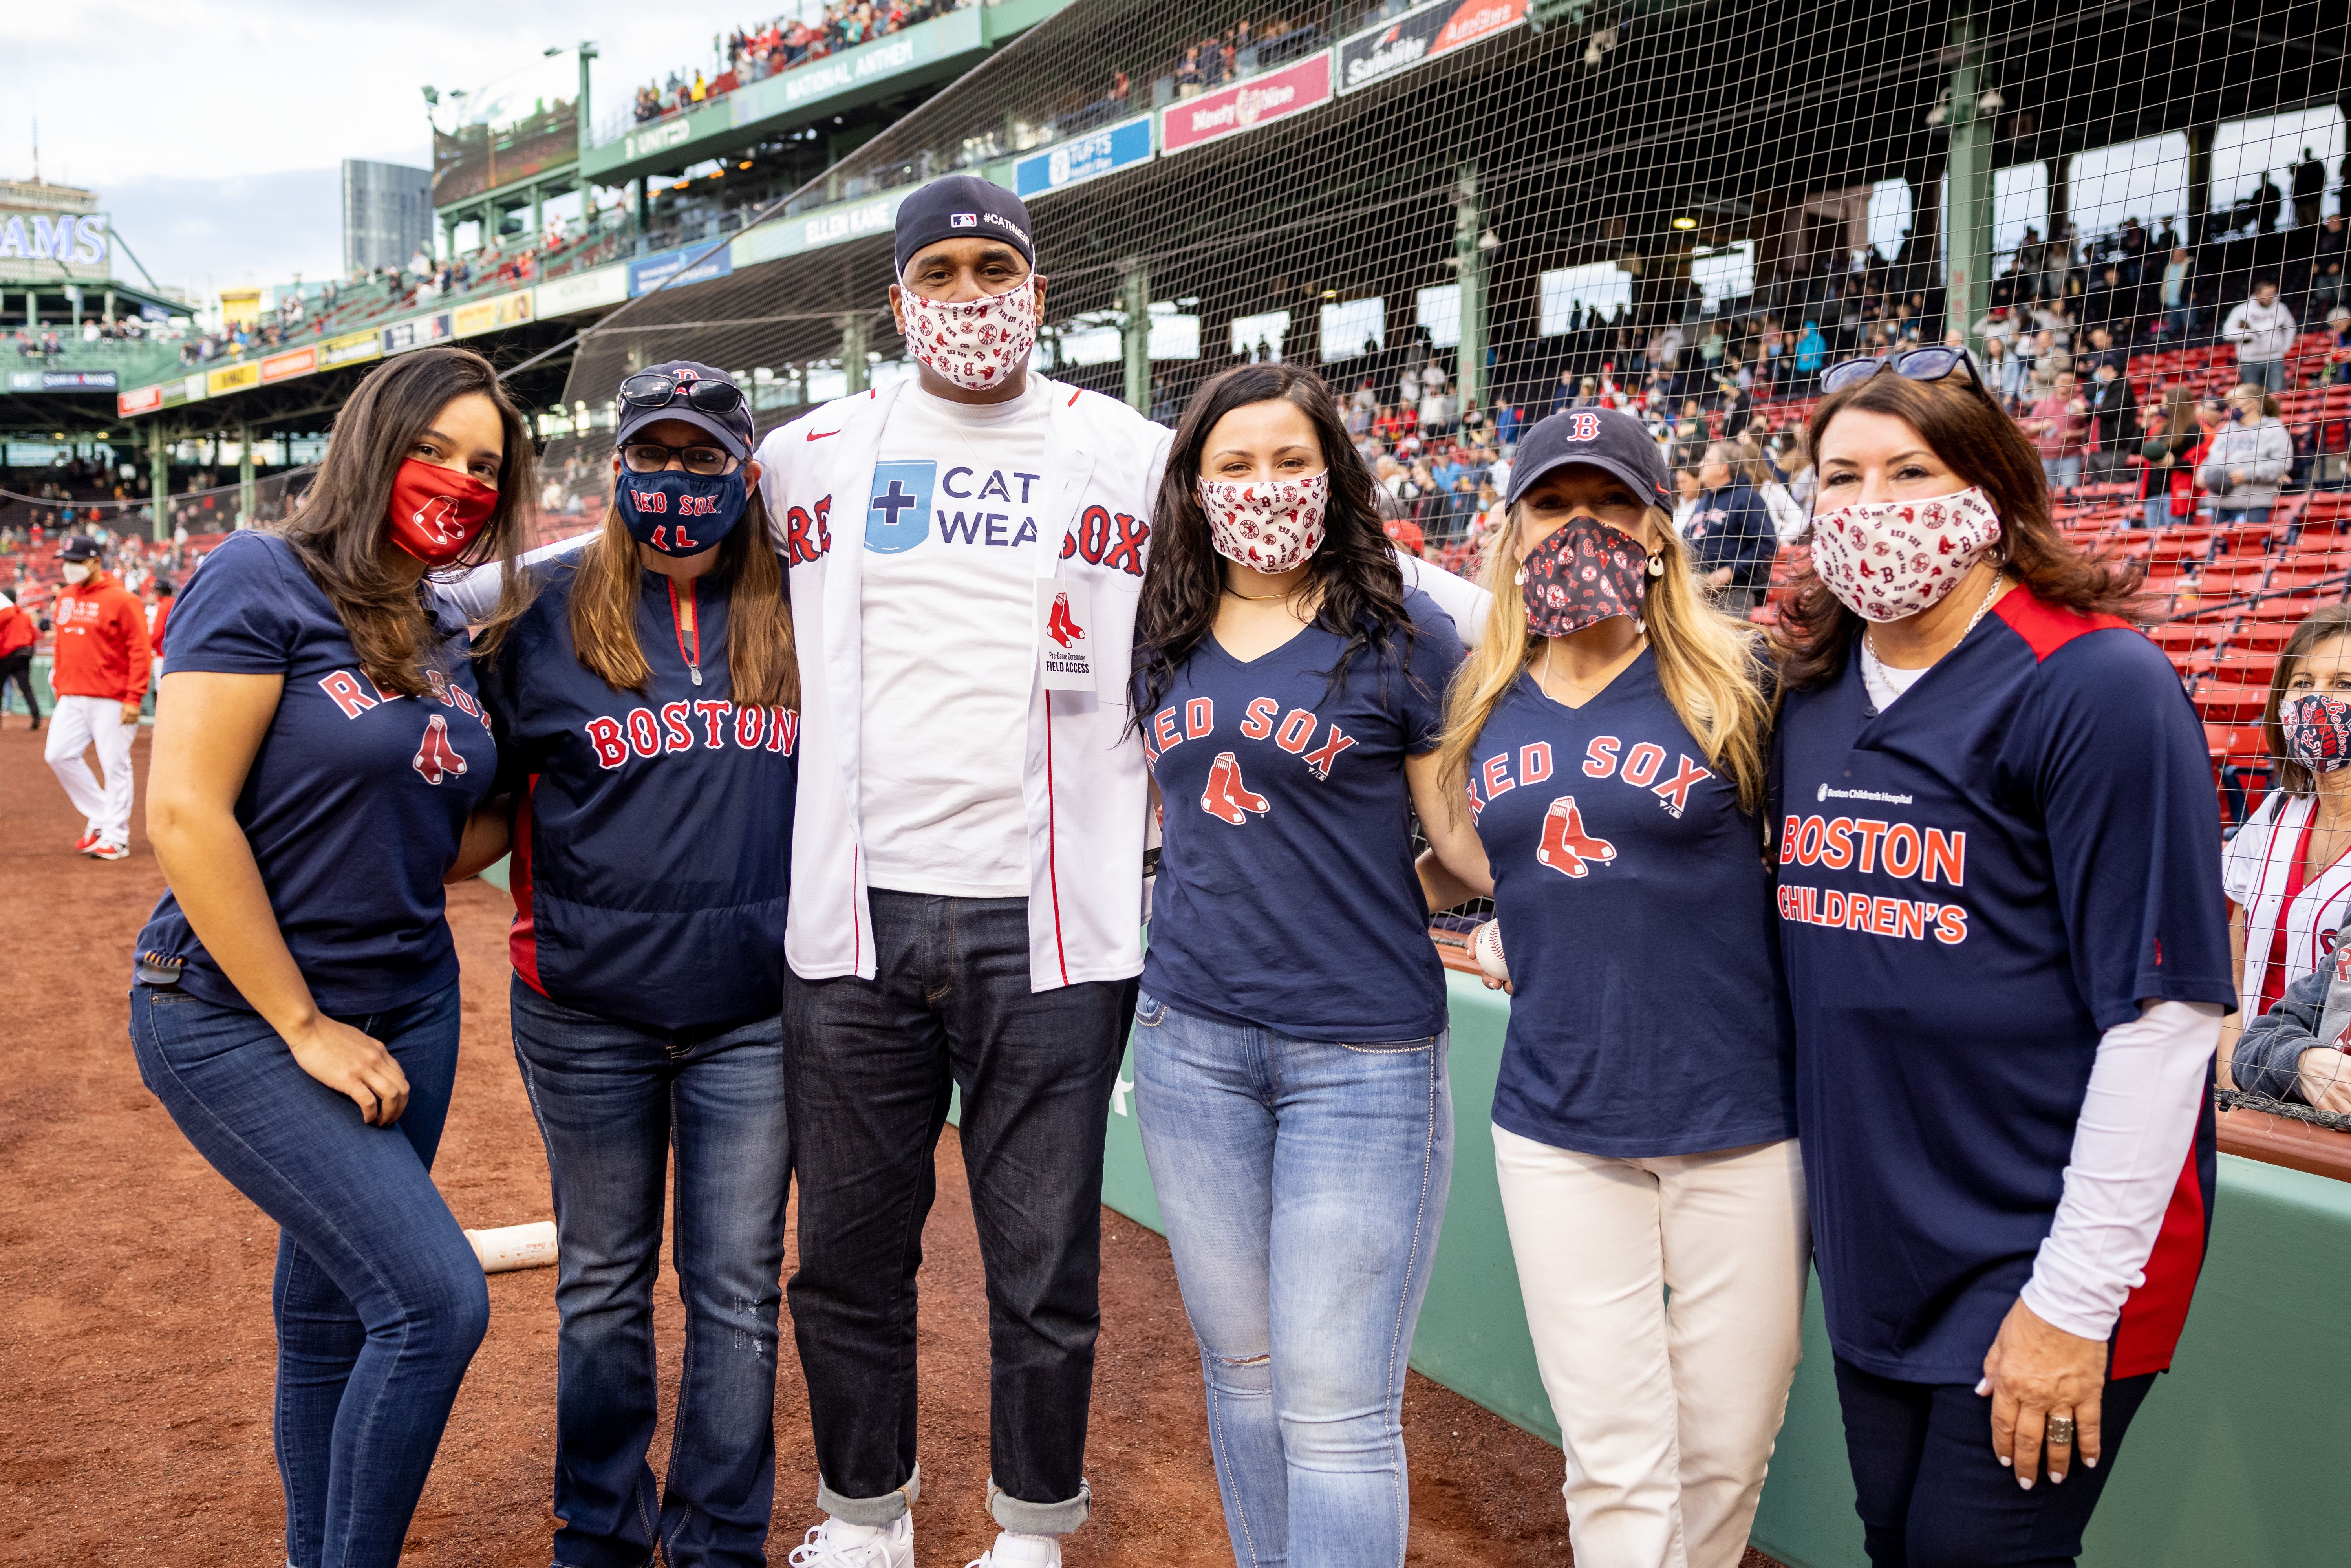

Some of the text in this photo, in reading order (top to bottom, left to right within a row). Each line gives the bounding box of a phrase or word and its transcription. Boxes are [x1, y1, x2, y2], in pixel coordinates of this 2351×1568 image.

[787, 38, 914, 99] NATIONAL ANTHEM
[638, 119, 690, 154] UNITED
[1070, 133, 1112, 165] TUFTS
[850, 201, 891, 233] KANE
[983, 212, 1030, 248] #CATHWEAR
[0, 214, 107, 265] AMS
[938, 312, 957, 338] RED SOX
[963, 362, 975, 376] B
[1566, 412, 1602, 442] B
[942, 467, 1041, 504] CAT
[630, 489, 667, 514] RED
[679, 494, 719, 516] SOX
[1259, 496, 1272, 507] B
[787, 493, 832, 568] RE
[937, 509, 1037, 547] WEA
[1219, 520, 1228, 531] RED
[1229, 532, 1238, 544] SOX
[1278, 525, 1299, 544] RED SOX
[1890, 529, 1922, 549] RED SOX
[1583, 538, 1596, 557] B
[1959, 536, 1972, 554] B
[1266, 554, 1276, 567] B
[1880, 567, 1895, 584] B
[1597, 601, 1612, 616] B
[1046, 661, 1089, 674] FIELD ACCESS
[1049, 651, 1085, 662] Pre-Game Ceremony
[584, 699, 800, 770] BOSTON
[1240, 697, 1357, 776] SOX
[2321, 697, 2349, 756] Boston
[1582, 736, 1712, 813] SOX
[1827, 789, 1913, 805] Boston Children's Hospital
[1779, 814, 1966, 887] BOSTON
[1777, 884, 1968, 945] CHILDREN'S
